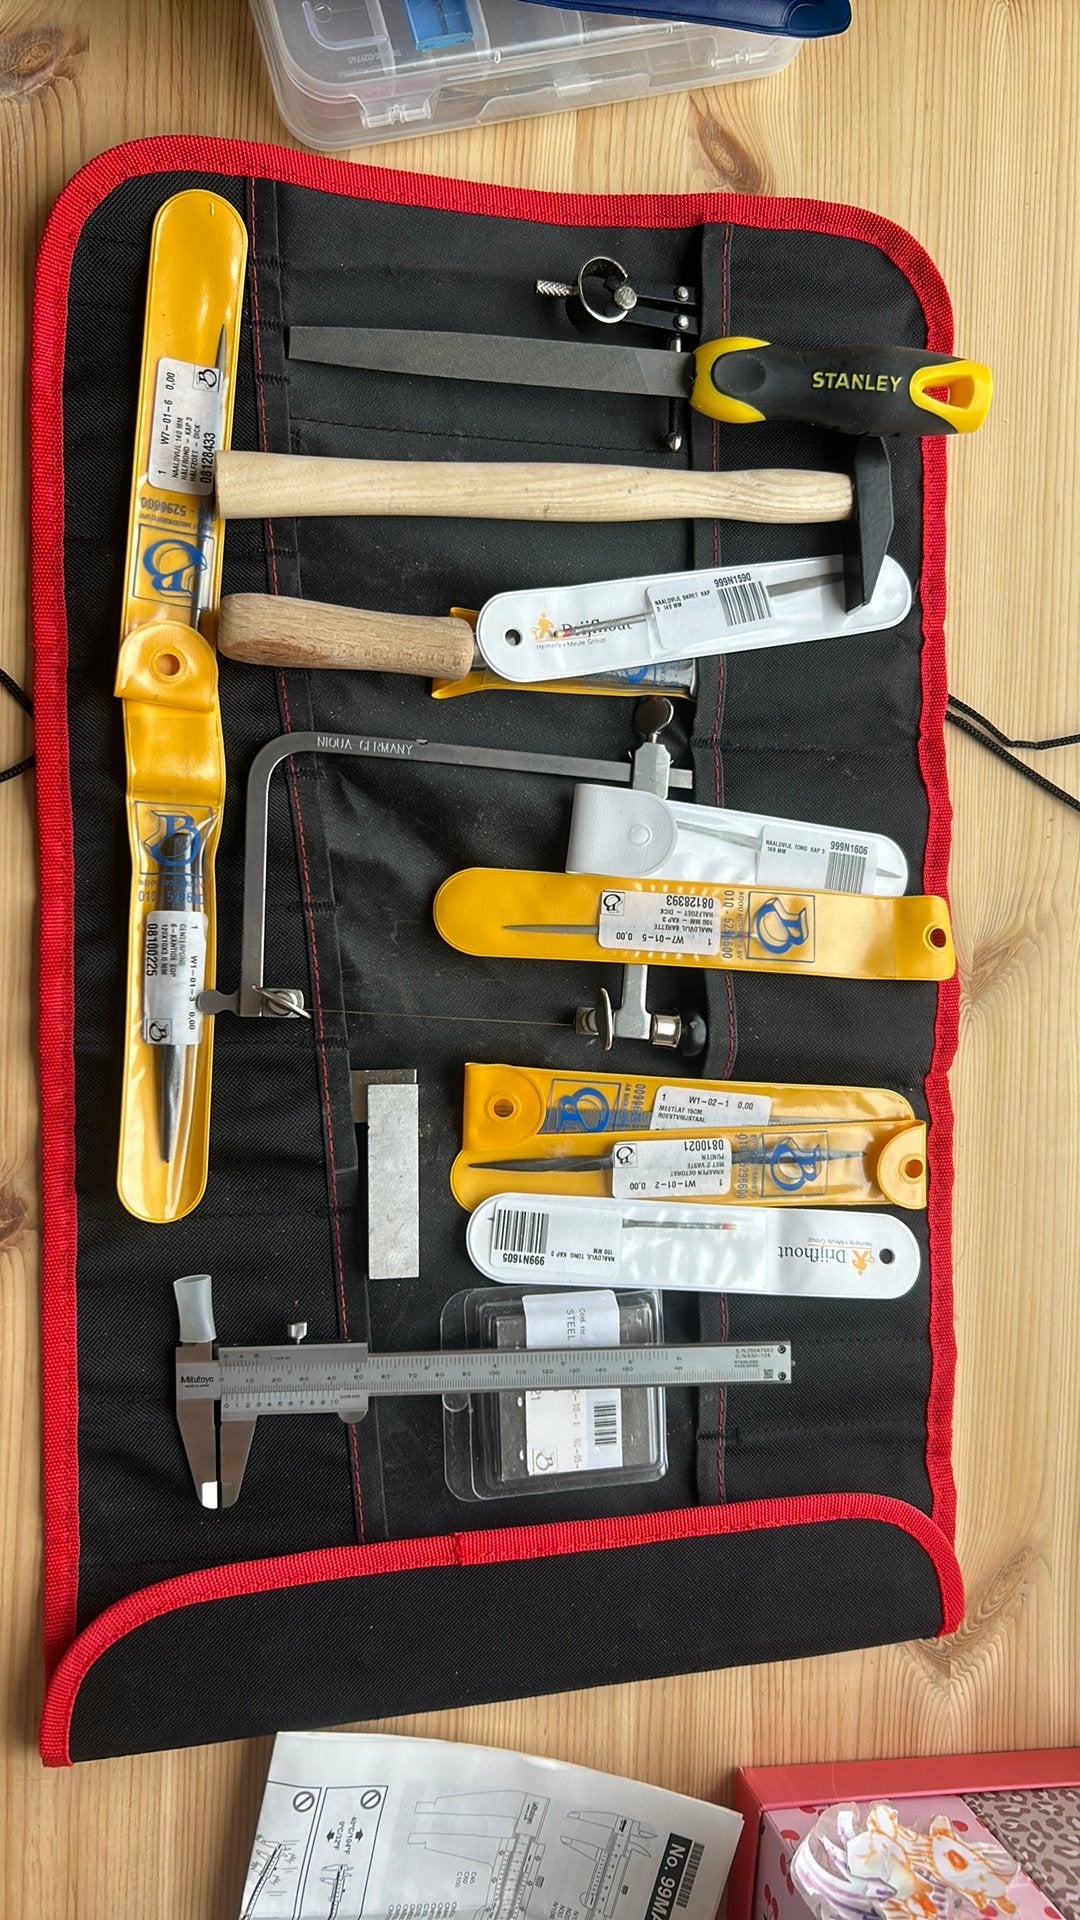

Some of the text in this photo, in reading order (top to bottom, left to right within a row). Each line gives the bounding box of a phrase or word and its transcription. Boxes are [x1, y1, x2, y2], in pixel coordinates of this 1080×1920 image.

[166, 372, 176, 391] 0,00
[812, 371, 902, 393] STANLEY
[160, 399, 174, 445] W7-01-6
[200, 431, 216, 484] 08128433
[714, 572, 752, 588] 999N1590
[830, 840, 869, 855] 999N1606
[666, 894, 714, 909] 08128393
[723, 889, 735, 908] 010
[615, 931, 633, 941] 0,00
[642, 933, 685, 944] W7-01-5
[146, 923, 158, 977] 08100225
[189, 955, 198, 1002] W1-01-3
[188, 1011, 196, 1030] 0,00
[662, 1093, 754, 1110] 1 W1-02-1 0,00
[684, 1139, 724, 1152] 0810021
[629, 1181, 646, 1191] 0,00
[655, 1180, 696, 1190] W1-01-2
[502, 1252, 545, 1266] 999N1605
[777, 1246, 846, 1263] Drijfhout
[566, 1308, 576, 1341] STEEL
[180, 1376, 214, 1384] Mitutoyo
[664, 1843, 686, 1871] No.
